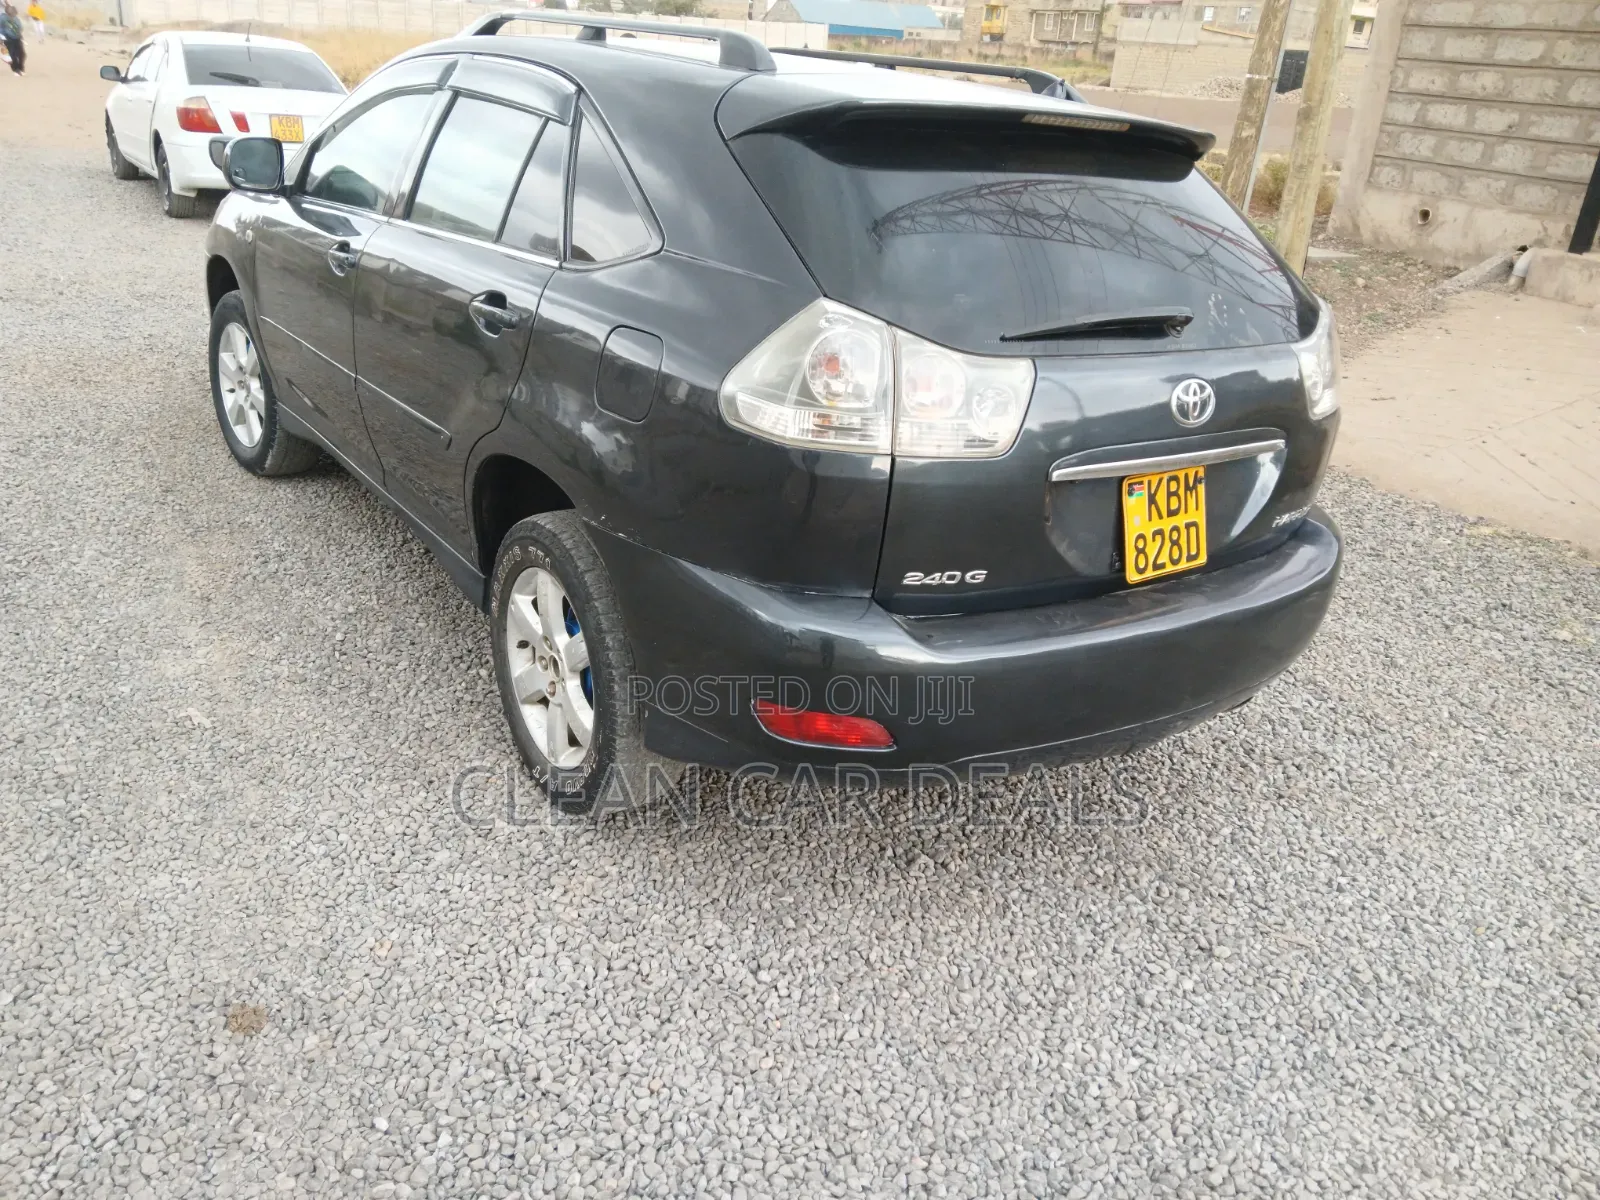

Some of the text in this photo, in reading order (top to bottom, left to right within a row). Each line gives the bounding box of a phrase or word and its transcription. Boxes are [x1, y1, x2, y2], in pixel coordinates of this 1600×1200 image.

[277, 116, 300, 129] KBM
[1146, 469, 1200, 523] KBM
[1133, 519, 1201, 576] 828D
[902, 569, 988, 585] 240 G
